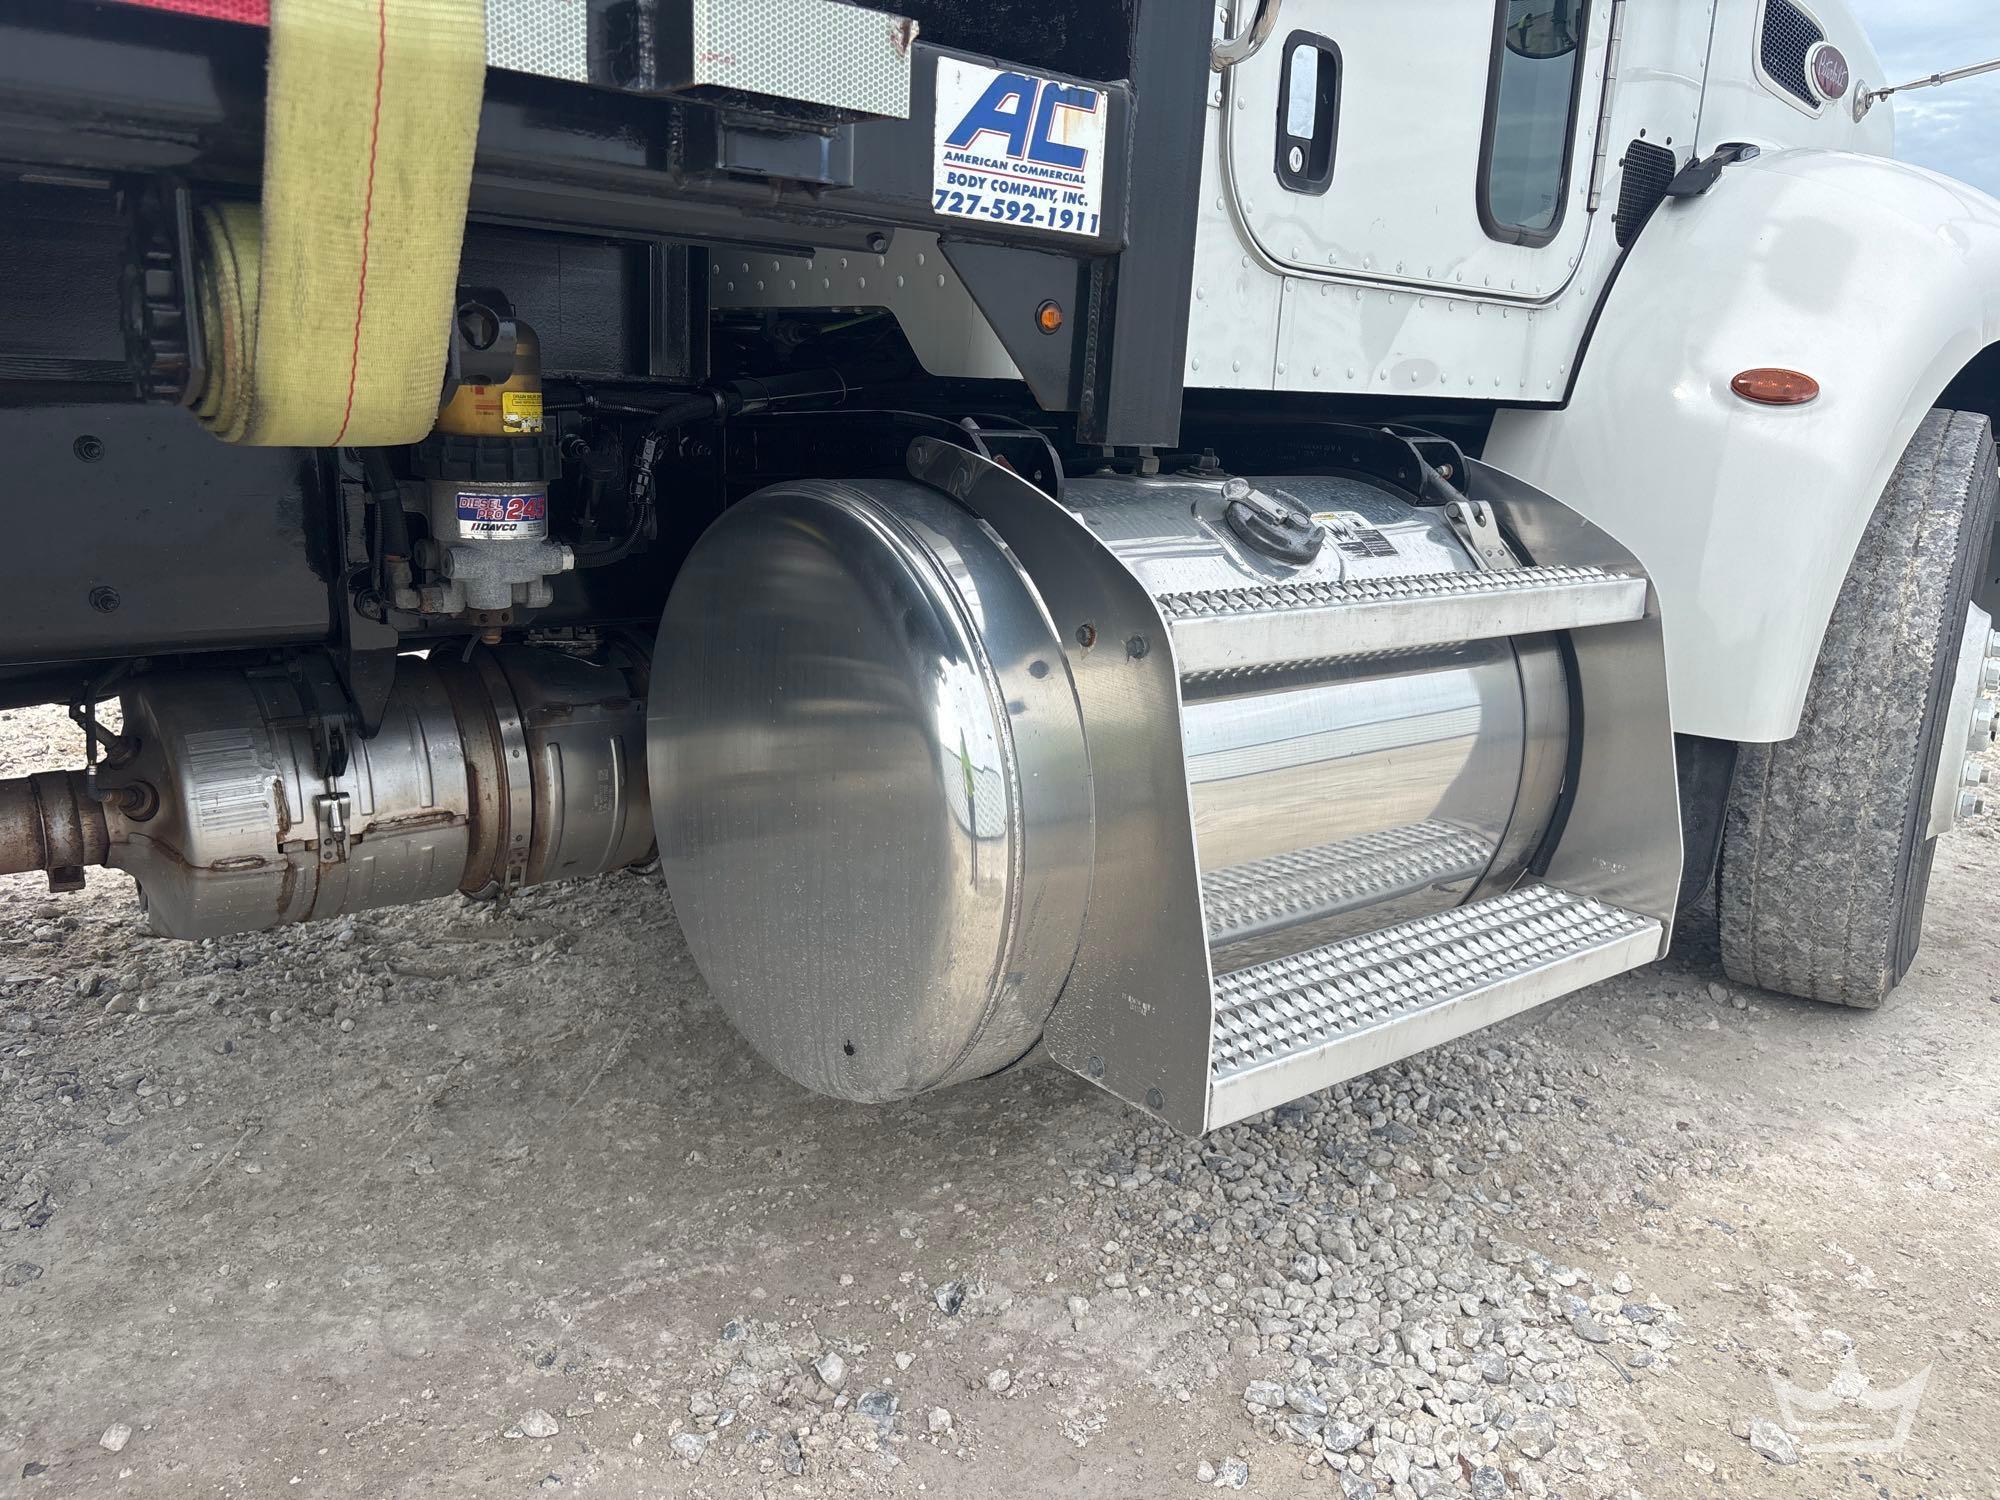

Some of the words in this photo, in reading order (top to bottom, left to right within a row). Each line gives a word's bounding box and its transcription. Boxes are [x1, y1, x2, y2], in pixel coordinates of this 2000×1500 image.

[943, 71, 1100, 172] AC
[944, 151, 1008, 170] AMERICAN
[1012, 163, 1086, 184] COMMERCIAL
[947, 171, 987, 190] BODY
[990, 179, 1058, 204] COMPANY,
[1062, 191, 1089, 206] INC.
[934, 188, 1100, 233] 727-592-1911
[459, 497, 503, 510] DIESEL
[476, 508, 504, 520] PRO
[480, 523, 518, 532] DAVCO
